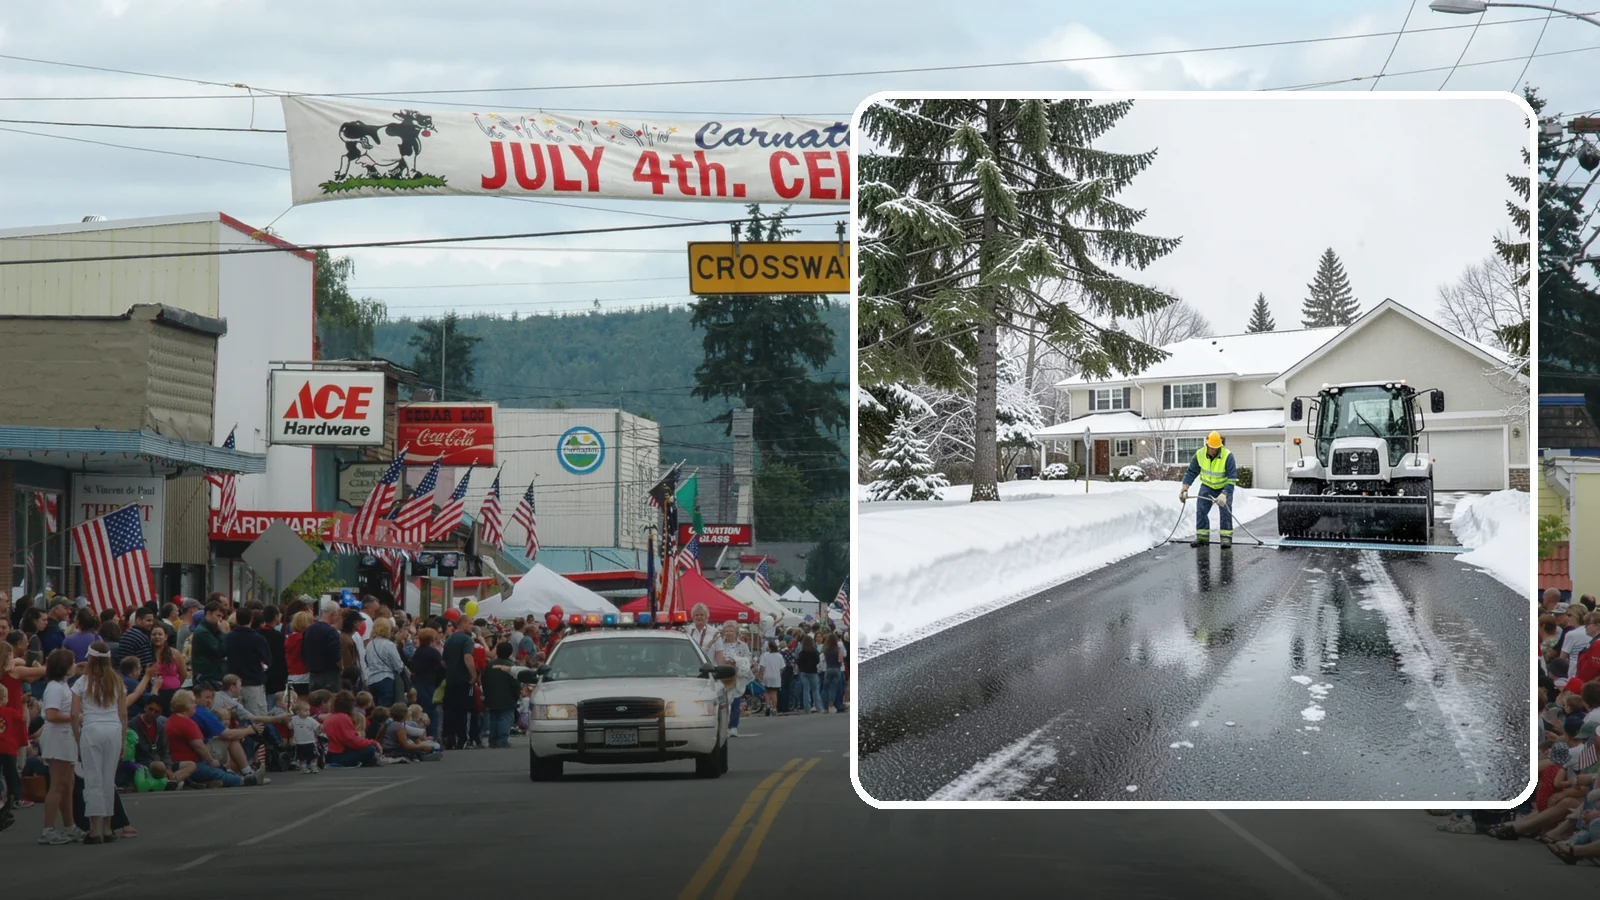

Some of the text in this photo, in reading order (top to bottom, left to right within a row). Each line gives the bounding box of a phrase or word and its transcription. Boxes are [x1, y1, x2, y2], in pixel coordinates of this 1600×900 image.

[695, 120, 850, 150] Carnat
[481, 141, 604, 193] JULY
[632, 150, 747, 198] 4th.
[697, 253, 850, 280] CROSSWA
[282, 380, 373, 419] ACE
[406, 409, 484, 421] CEDAR LOG
[283, 421, 371, 436] Hardware
[416, 428, 477, 447] Coca-Cola
[353, 467, 386, 481] Simpl
[96, 485, 124, 495] Vincent
[126, 486, 135, 495] de
[137, 486, 155, 495] Paul
[81, 503, 153, 522] THT
[688, 526, 742, 535] CRNATION
[699, 535, 730, 543] GLASS
